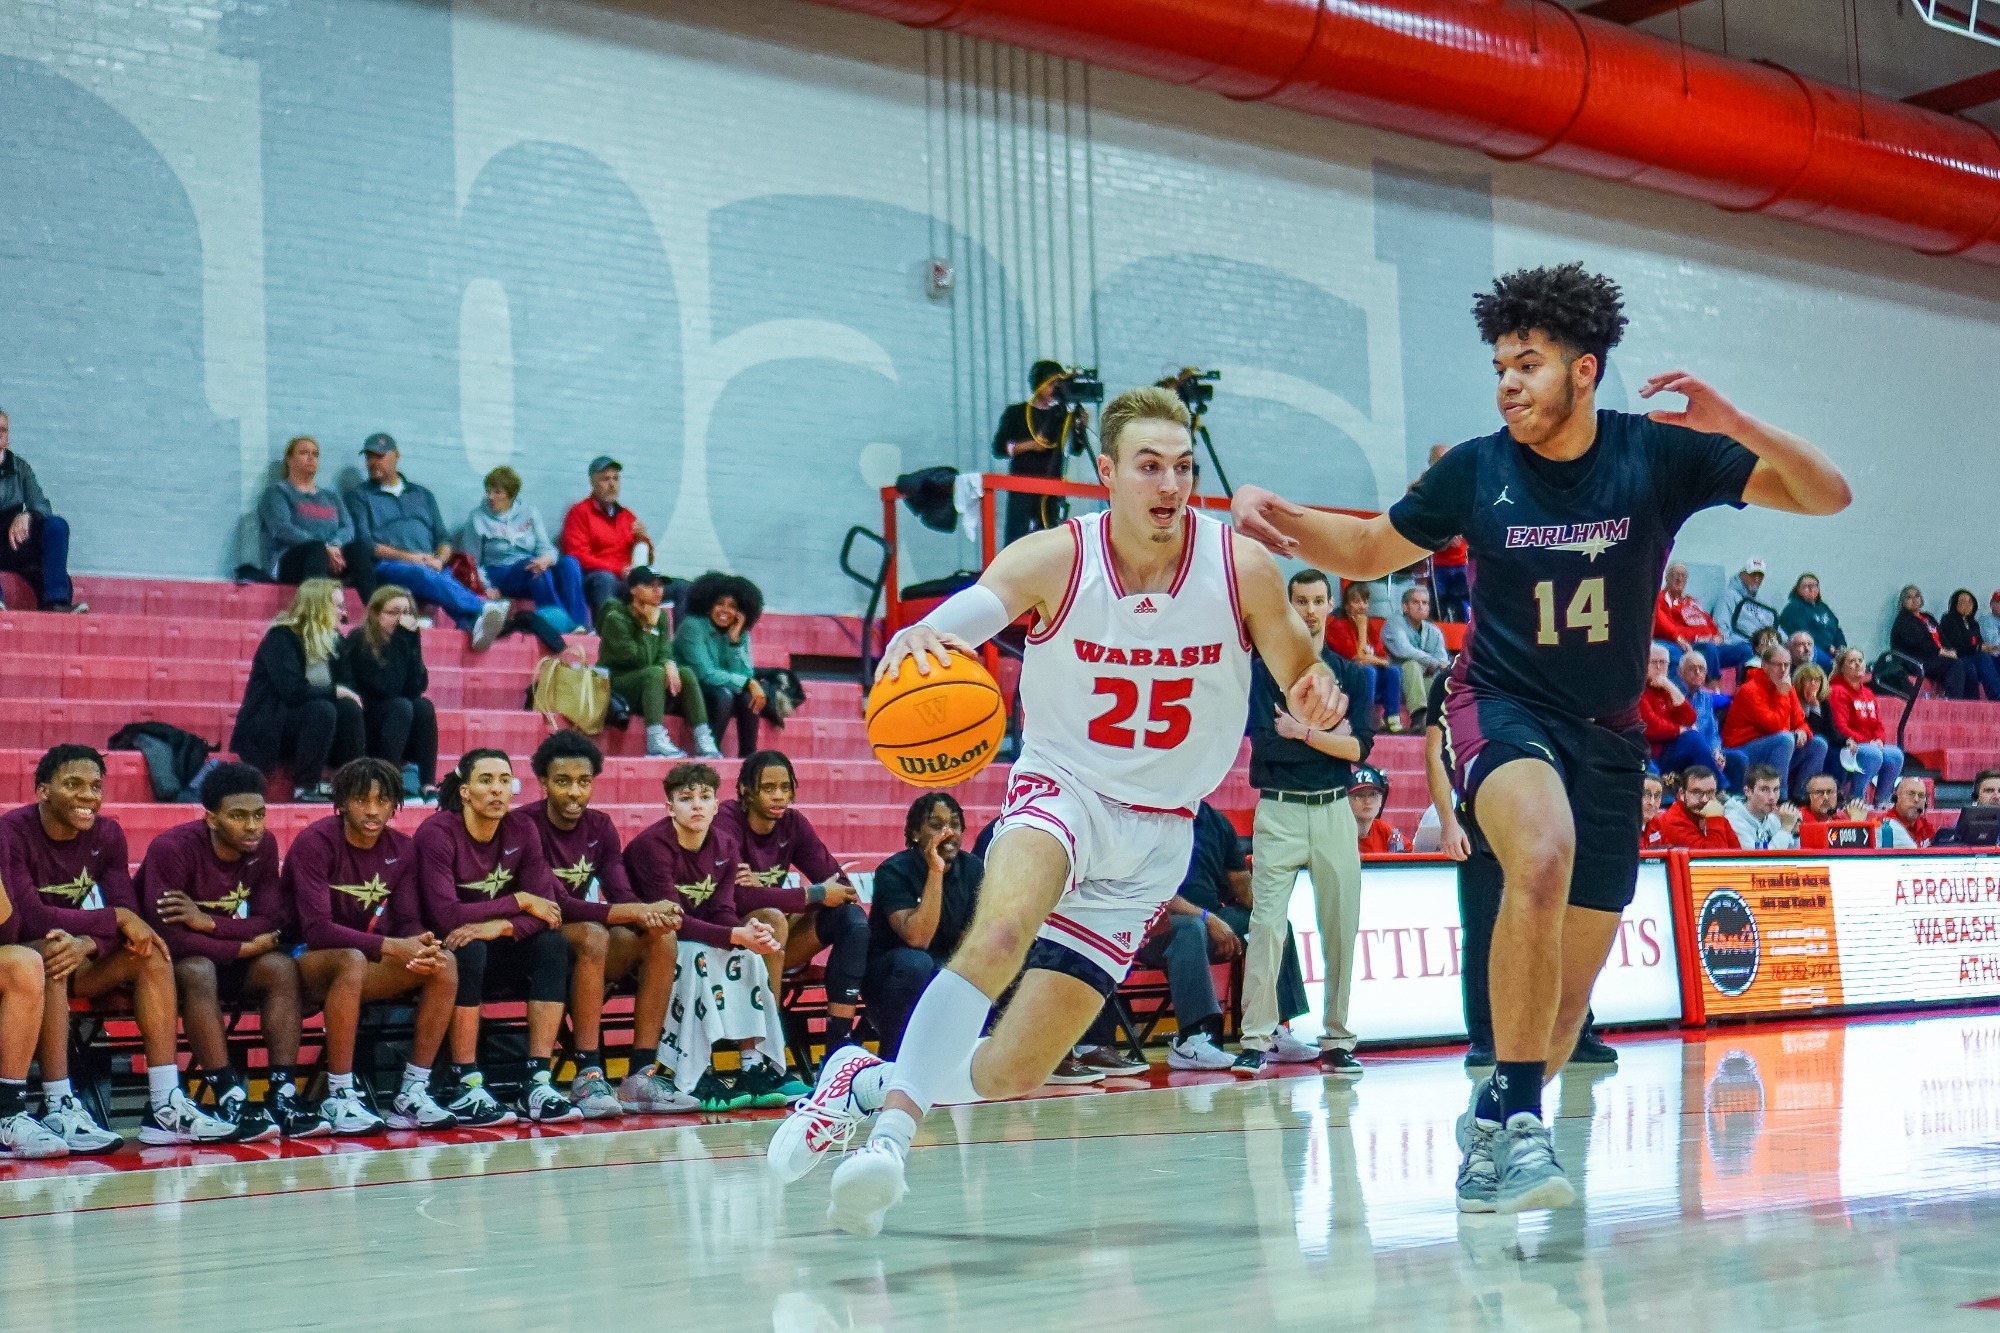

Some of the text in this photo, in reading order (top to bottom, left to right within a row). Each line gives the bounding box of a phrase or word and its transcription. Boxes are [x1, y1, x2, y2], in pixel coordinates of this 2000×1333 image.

[1505, 517, 1630, 548] EARLHAM
[1534, 576, 1609, 646] 14
[1073, 638, 1223, 668] WABASH
[1088, 677, 1194, 749] 25
[897, 739, 989, 775] Wilson
[1355, 771, 1374, 783] 72
[1895, 877, 2000, 906] A PROUD P
[1913, 916, 1997, 946] WABASH
[725, 955, 742, 981] G
[1298, 926, 1463, 984] LTTLE
